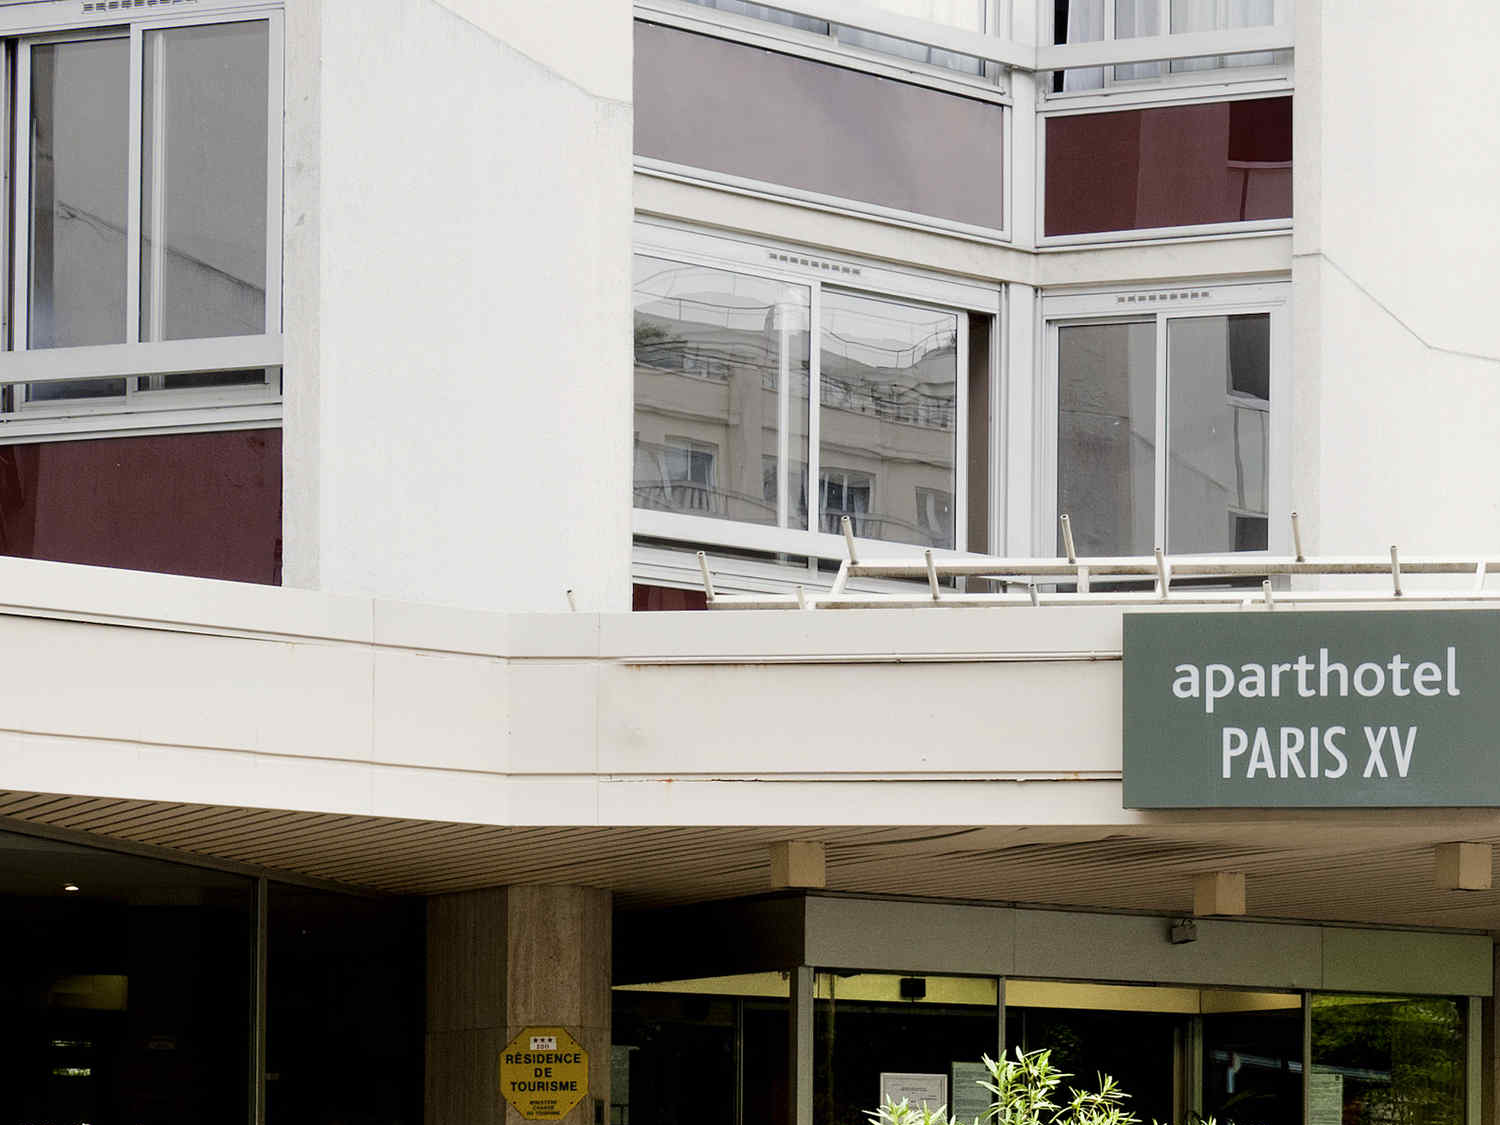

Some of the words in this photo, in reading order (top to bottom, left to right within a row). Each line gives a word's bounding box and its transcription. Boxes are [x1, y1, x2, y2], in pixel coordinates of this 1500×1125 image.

[1171, 646, 1461, 713] aparthotel
[1222, 725, 1348, 779] PARIS
[1362, 725, 1418, 779] XV
[510, 1080, 577, 1092] TOURISME
[533, 1067, 553, 1078] DE
